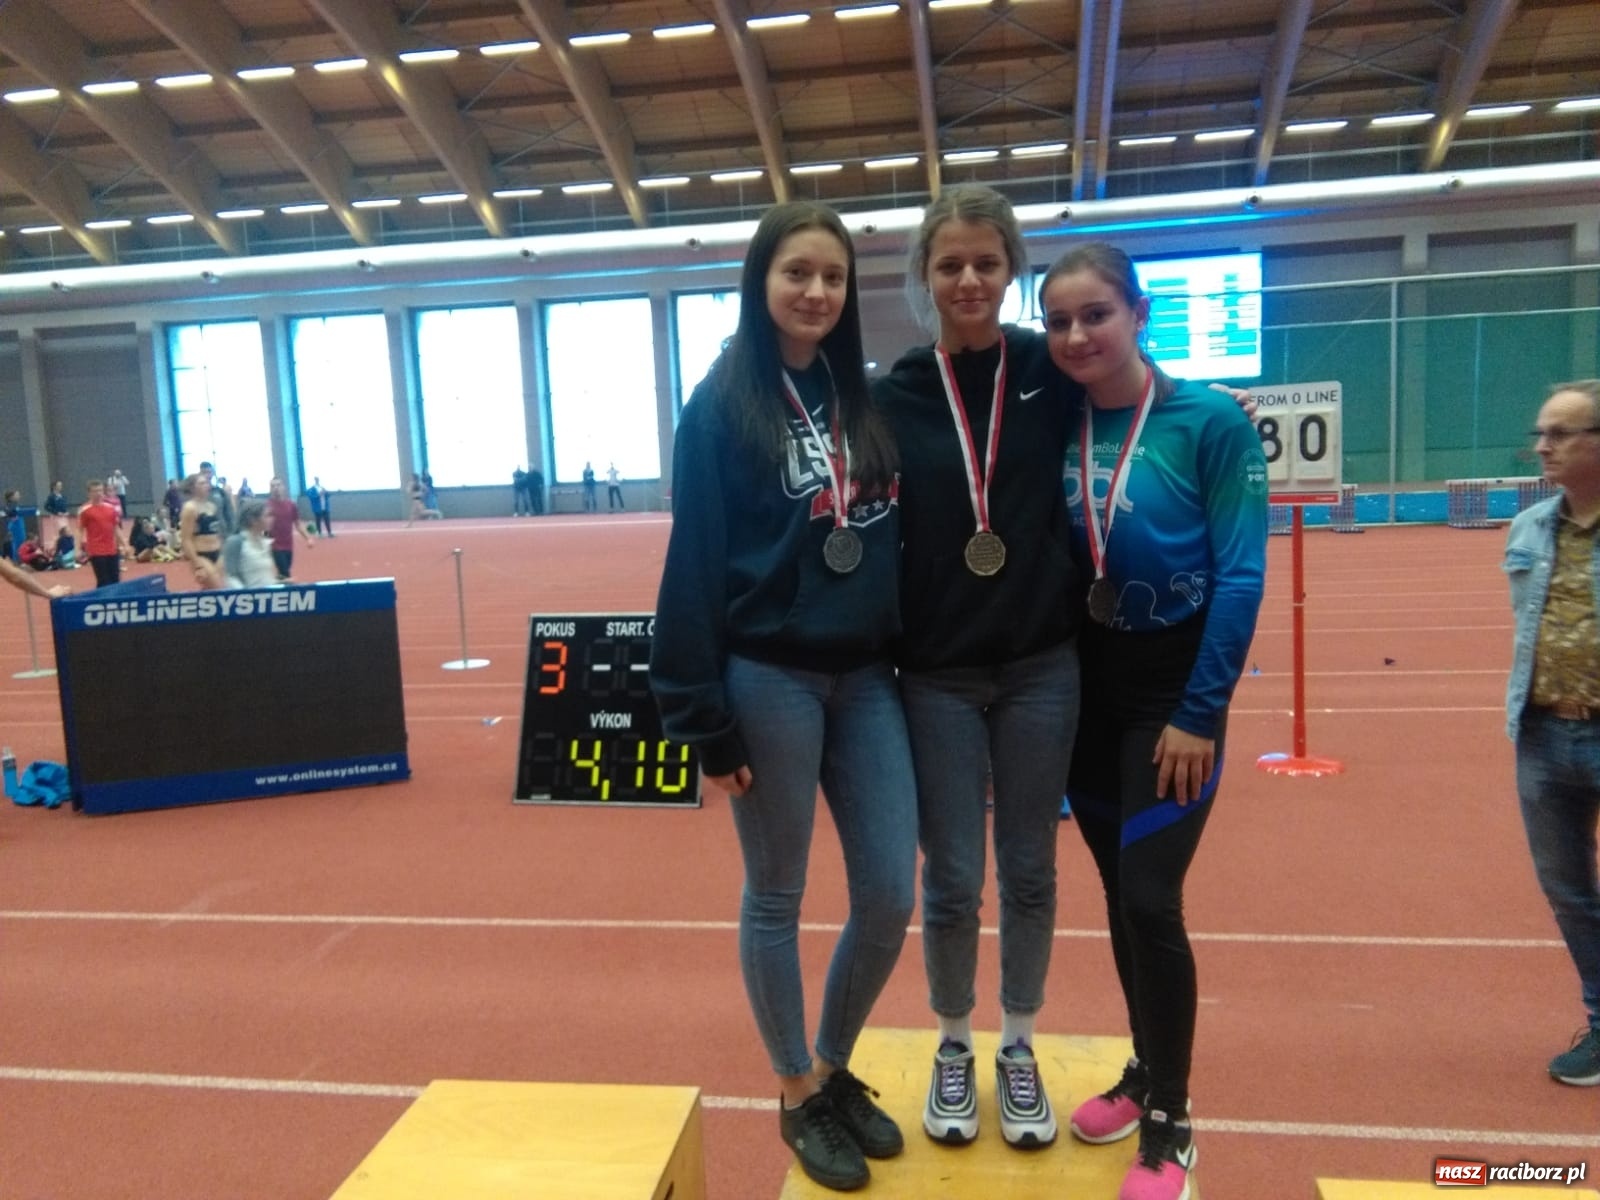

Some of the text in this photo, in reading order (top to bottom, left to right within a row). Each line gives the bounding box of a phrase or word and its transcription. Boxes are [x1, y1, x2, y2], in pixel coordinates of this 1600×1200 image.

[1306, 390, 1339, 403] LINE
[84, 590, 316, 626] ONLINESYSTEM
[536, 622, 576, 637] POKUS
[606, 622, 645, 637] START.
[539, 641, 567, 694] 3
[590, 710, 632, 729] VÝKON
[255, 762, 398, 786] www.onlinesystem.cz
[570, 739, 689, 801] 4,10
